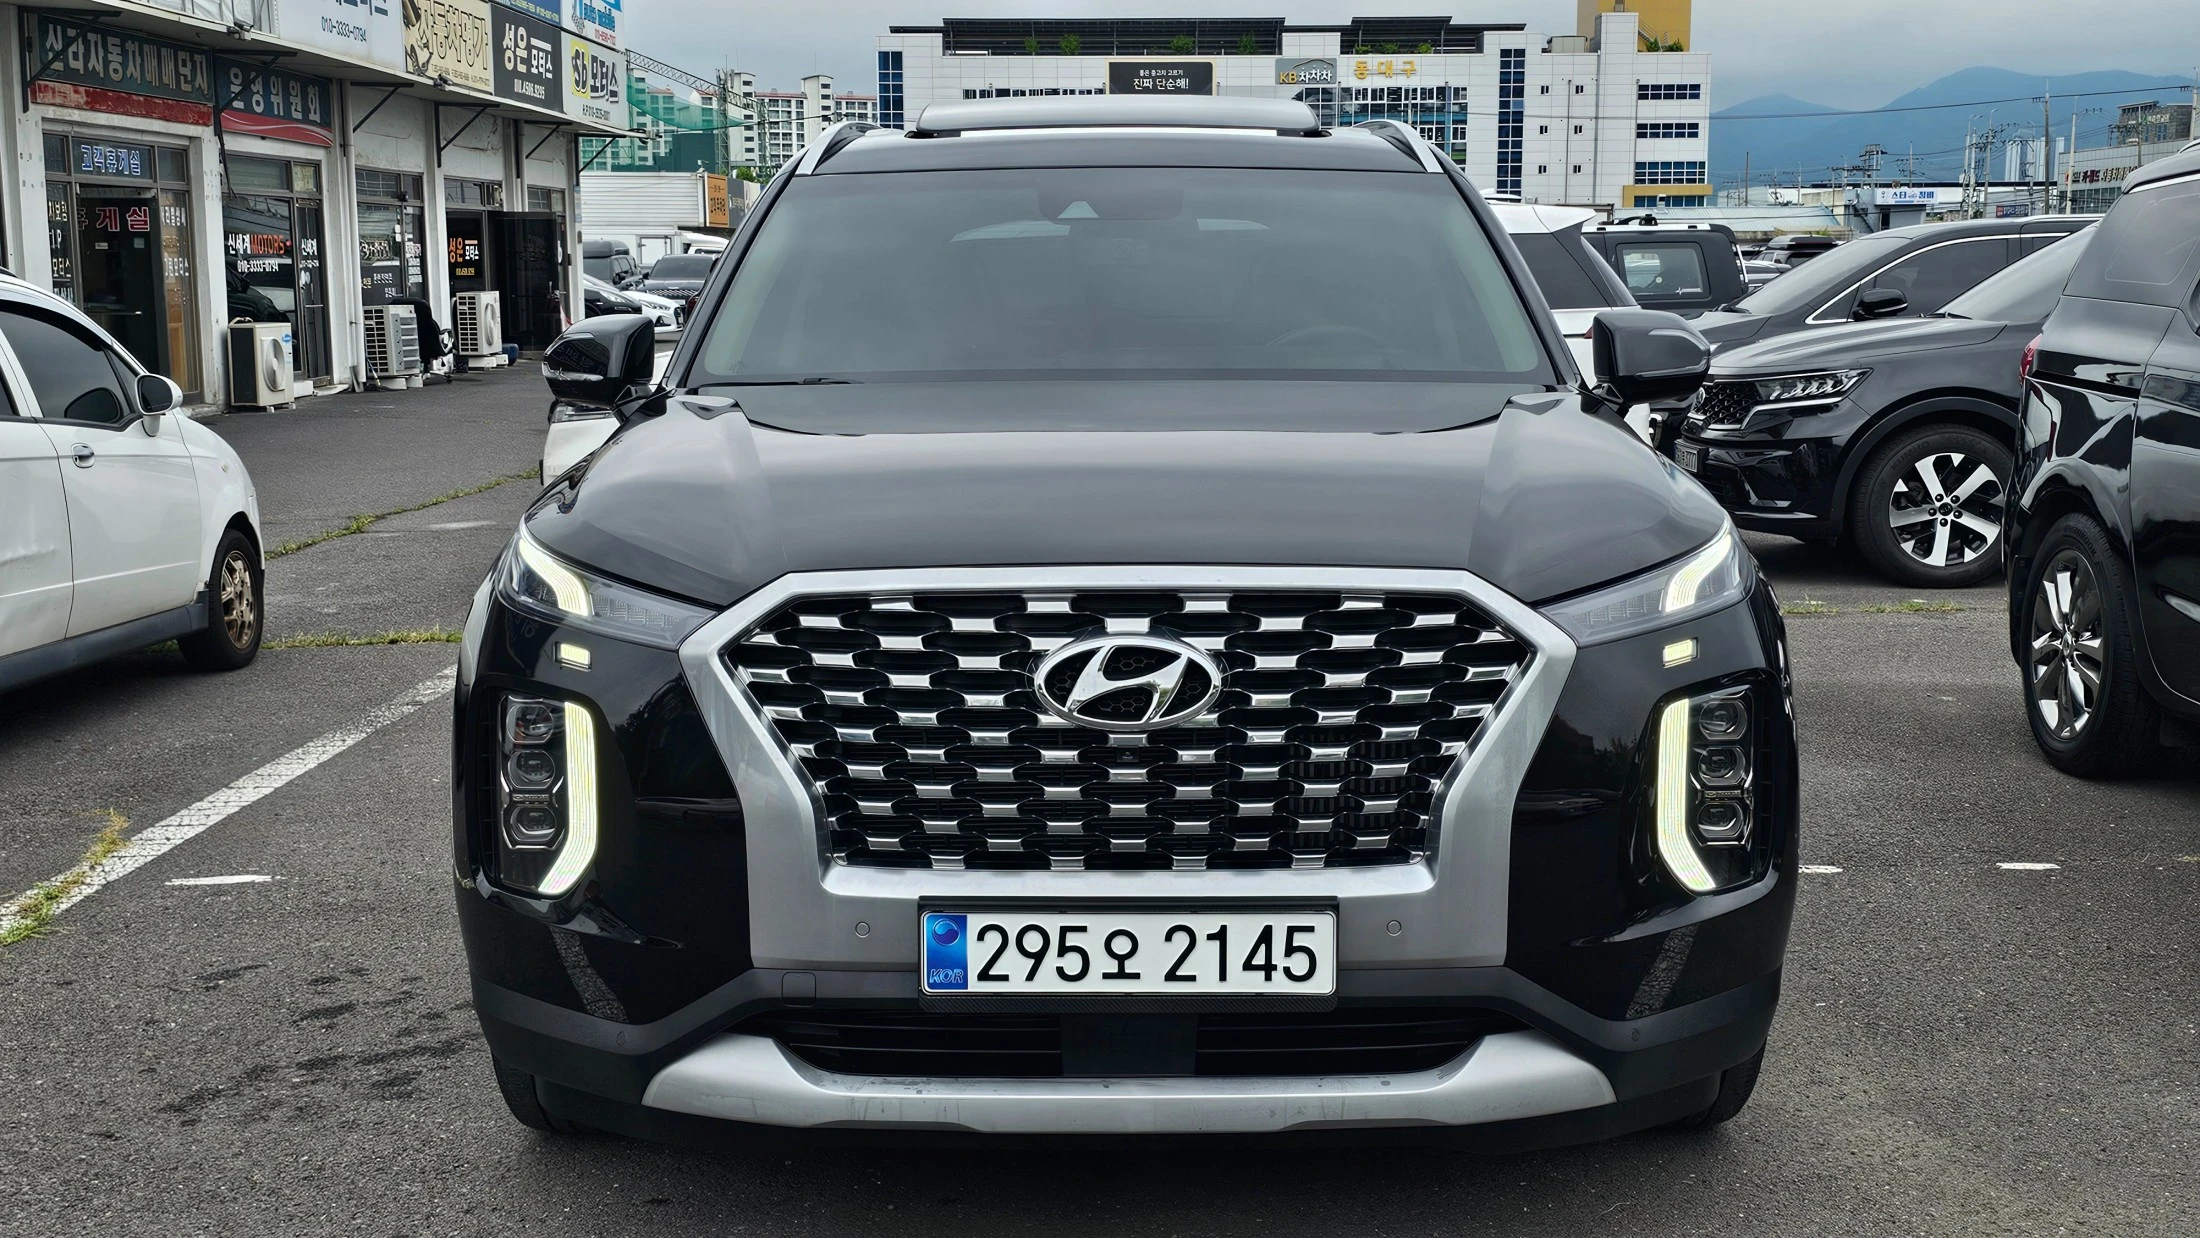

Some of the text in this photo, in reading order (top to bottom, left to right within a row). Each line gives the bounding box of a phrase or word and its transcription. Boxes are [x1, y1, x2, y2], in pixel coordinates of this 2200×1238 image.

[503, 23, 527, 73] 성은
[531, 49, 552, 79] 모터스
[1133, 78, 1189, 90] 진짜 단순해!
[1354, 60, 1416, 79] 동대구
[230, 67, 320, 123] 운영위원회
[81, 145, 140, 175] 고객휴게실
[976, 924, 1318, 982] 295오 2145
[929, 968, 964, 984] KOR
